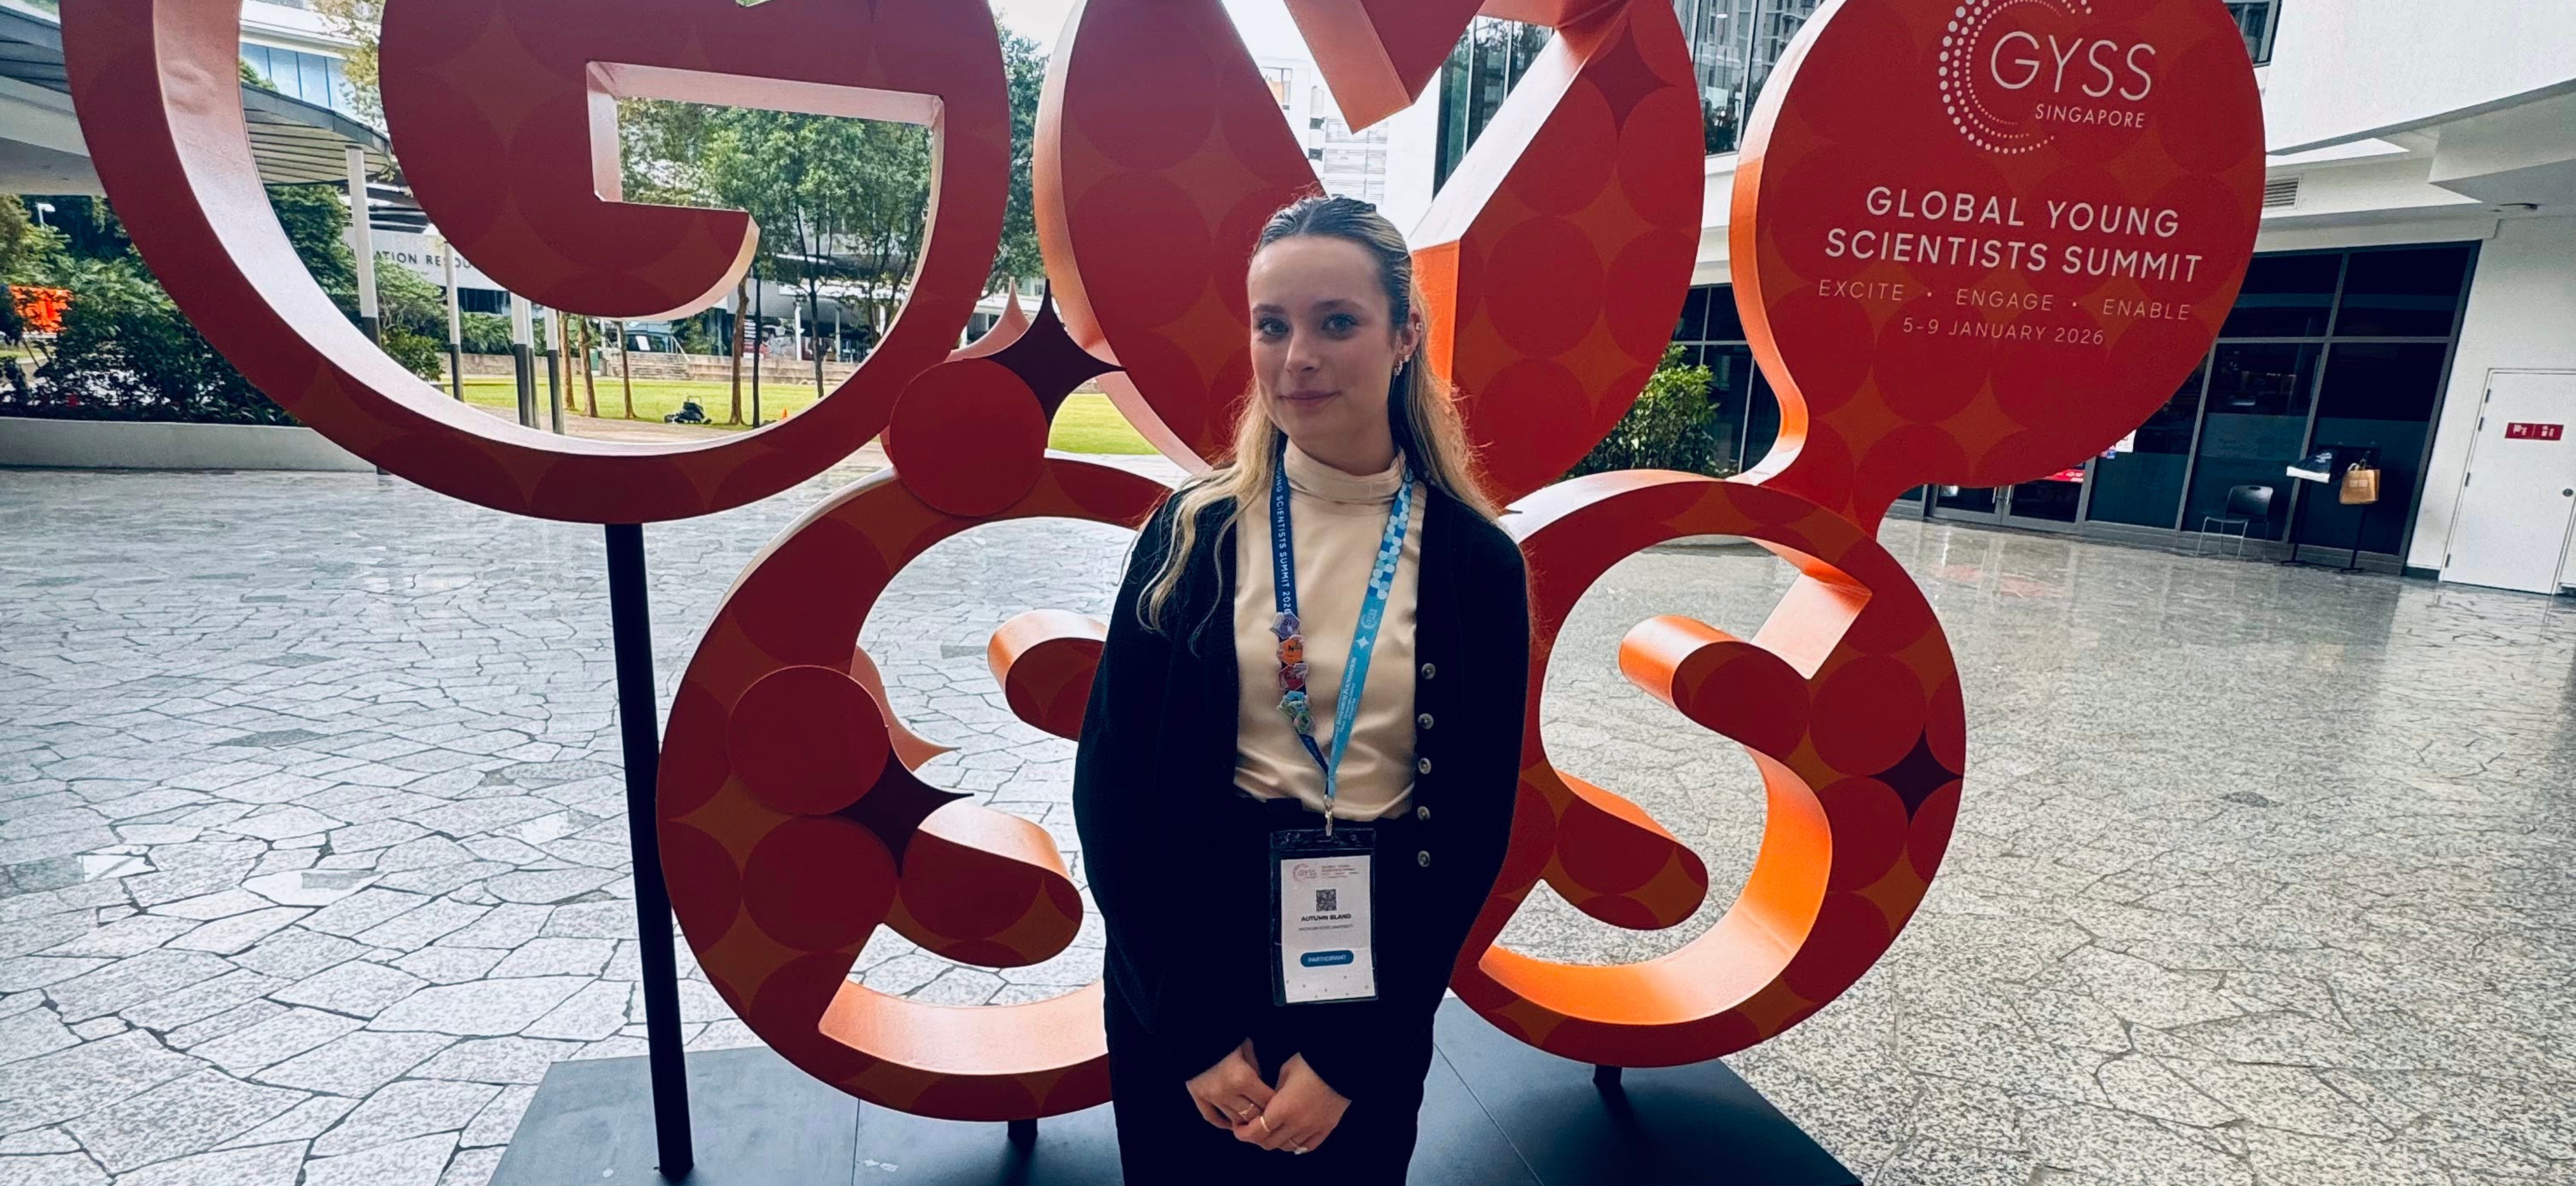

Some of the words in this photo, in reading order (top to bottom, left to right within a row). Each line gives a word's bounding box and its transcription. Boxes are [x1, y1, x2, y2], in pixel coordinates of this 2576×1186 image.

[1990, 30, 2156, 101] GYSS
[2035, 103, 2146, 128] SINGAPORE
[1866, 186, 2025, 227] GLOBAL
[2047, 200, 2179, 238] YOUNG
[1825, 228, 2048, 272] SCIENTISTS
[2061, 245, 2203, 282] SUMMIT
[1819, 279, 1905, 301] EXCITE
[1956, 288, 2054, 311] ENGAGE
[2103, 299, 2191, 320] ENABLE
[1903, 317, 1939, 334] 5-9
[1949, 321, 2046, 340] JANUARY
[2055, 327, 2103, 345] 2026
[1276, 495, 1287, 549] SCIENTISTS
[1279, 551, 1290, 588] SUMMIT
[1308, 954, 1346, 963] PARTICIPANT
